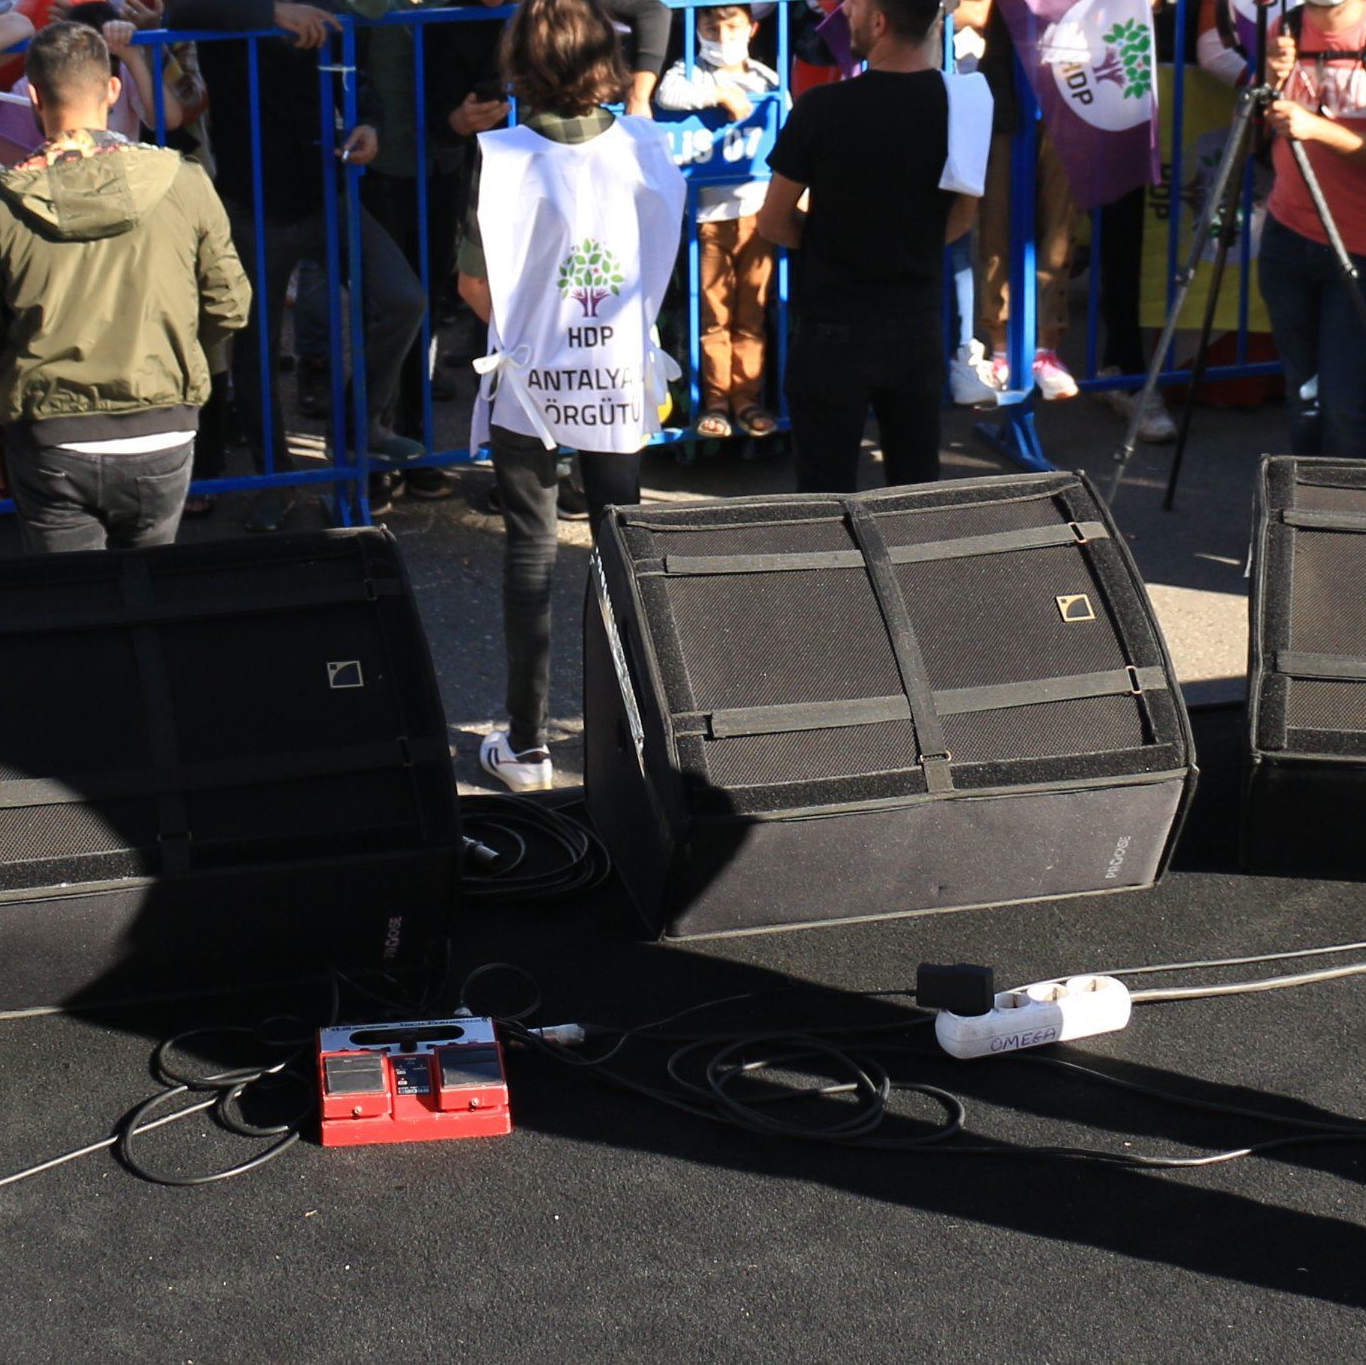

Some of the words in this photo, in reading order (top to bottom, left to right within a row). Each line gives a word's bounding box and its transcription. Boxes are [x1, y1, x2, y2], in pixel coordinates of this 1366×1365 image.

[568, 326, 614, 348] HDP
[528, 367, 633, 391] ANTALYA
[990, 1027, 1057, 1052] OMEGA
